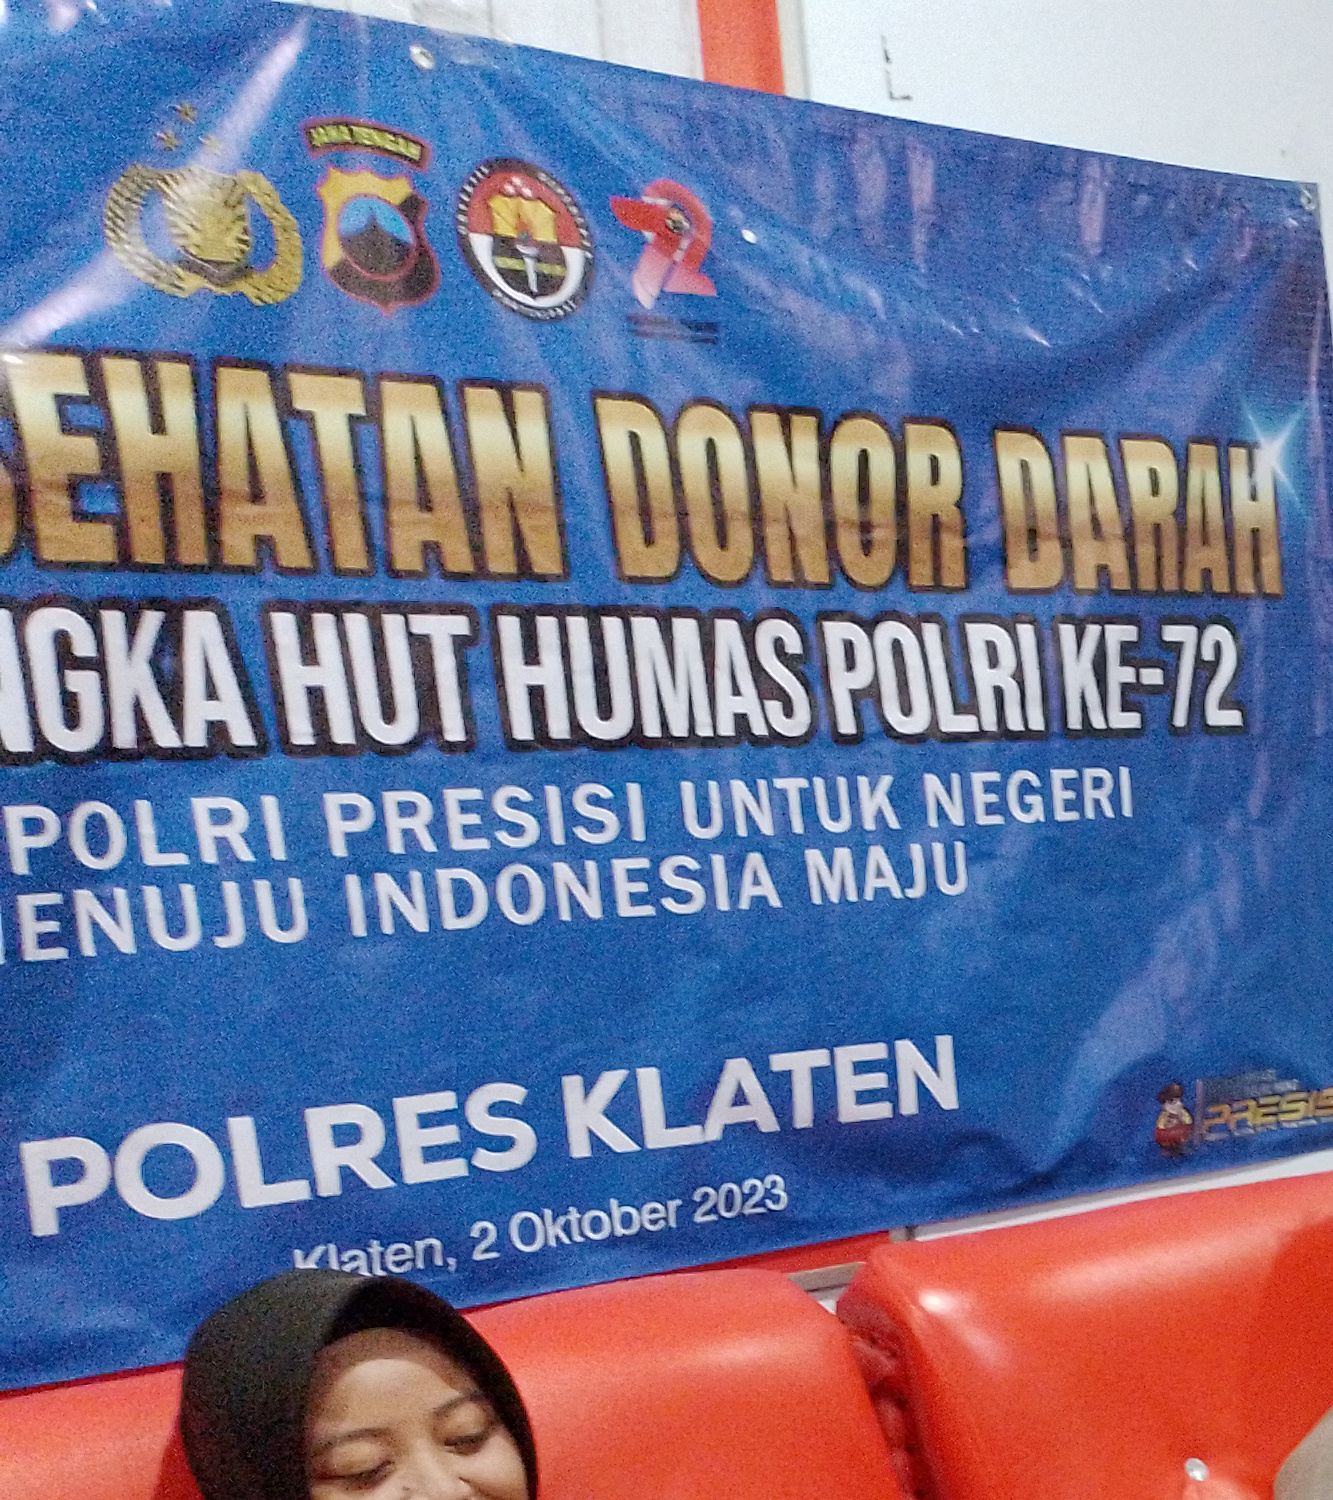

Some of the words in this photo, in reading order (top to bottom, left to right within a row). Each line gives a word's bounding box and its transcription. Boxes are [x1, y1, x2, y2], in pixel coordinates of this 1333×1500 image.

[0, 350, 567, 578] EHATAN
[596, 394, 968, 590] DONOR
[995, 427, 1284, 596] DARAH
[269, 611, 472, 746] HUT
[497, 613, 811, 741] HUMAS
[819, 619, 1045, 736] POLRI
[1057, 622, 1244, 732] KE-72
[3, 794, 288, 876] POLRI
[323, 782, 647, 858] PRESISI
[680, 774, 901, 840] UNTUK
[924, 766, 1134, 828] NEGERI
[0, 878, 309, 964] ENUJU
[344, 852, 782, 938] INDONESIA
[803, 840, 968, 905] MAJU
[19, 1081, 538, 1237] POLRES
[561, 1034, 959, 1159] KLATEN
[470, 1221, 500, 1261] 2
[508, 1198, 683, 1253] Oktober
[692, 1174, 789, 1223] 2023
